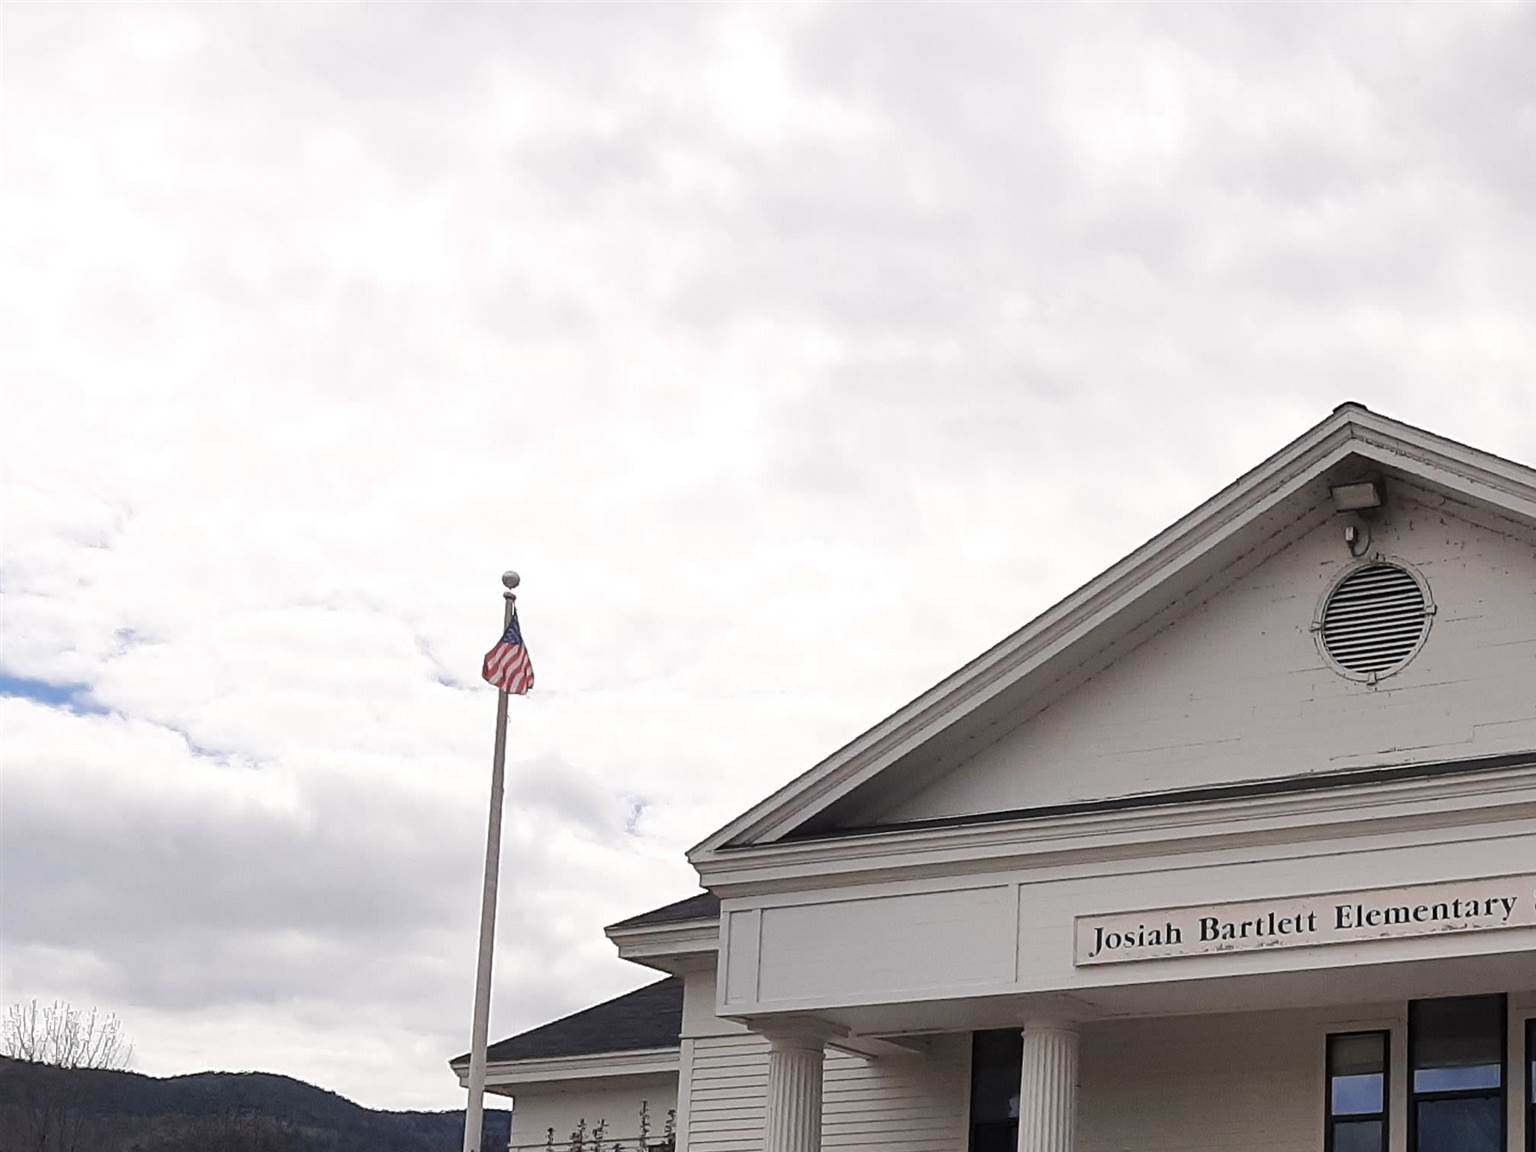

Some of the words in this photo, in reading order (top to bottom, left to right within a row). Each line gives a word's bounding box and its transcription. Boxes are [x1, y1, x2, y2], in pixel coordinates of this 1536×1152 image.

[1089, 922, 1182, 957] Josiah
[1200, 910, 1317, 942] Bartlett
[1334, 895, 1518, 930] Elementary
